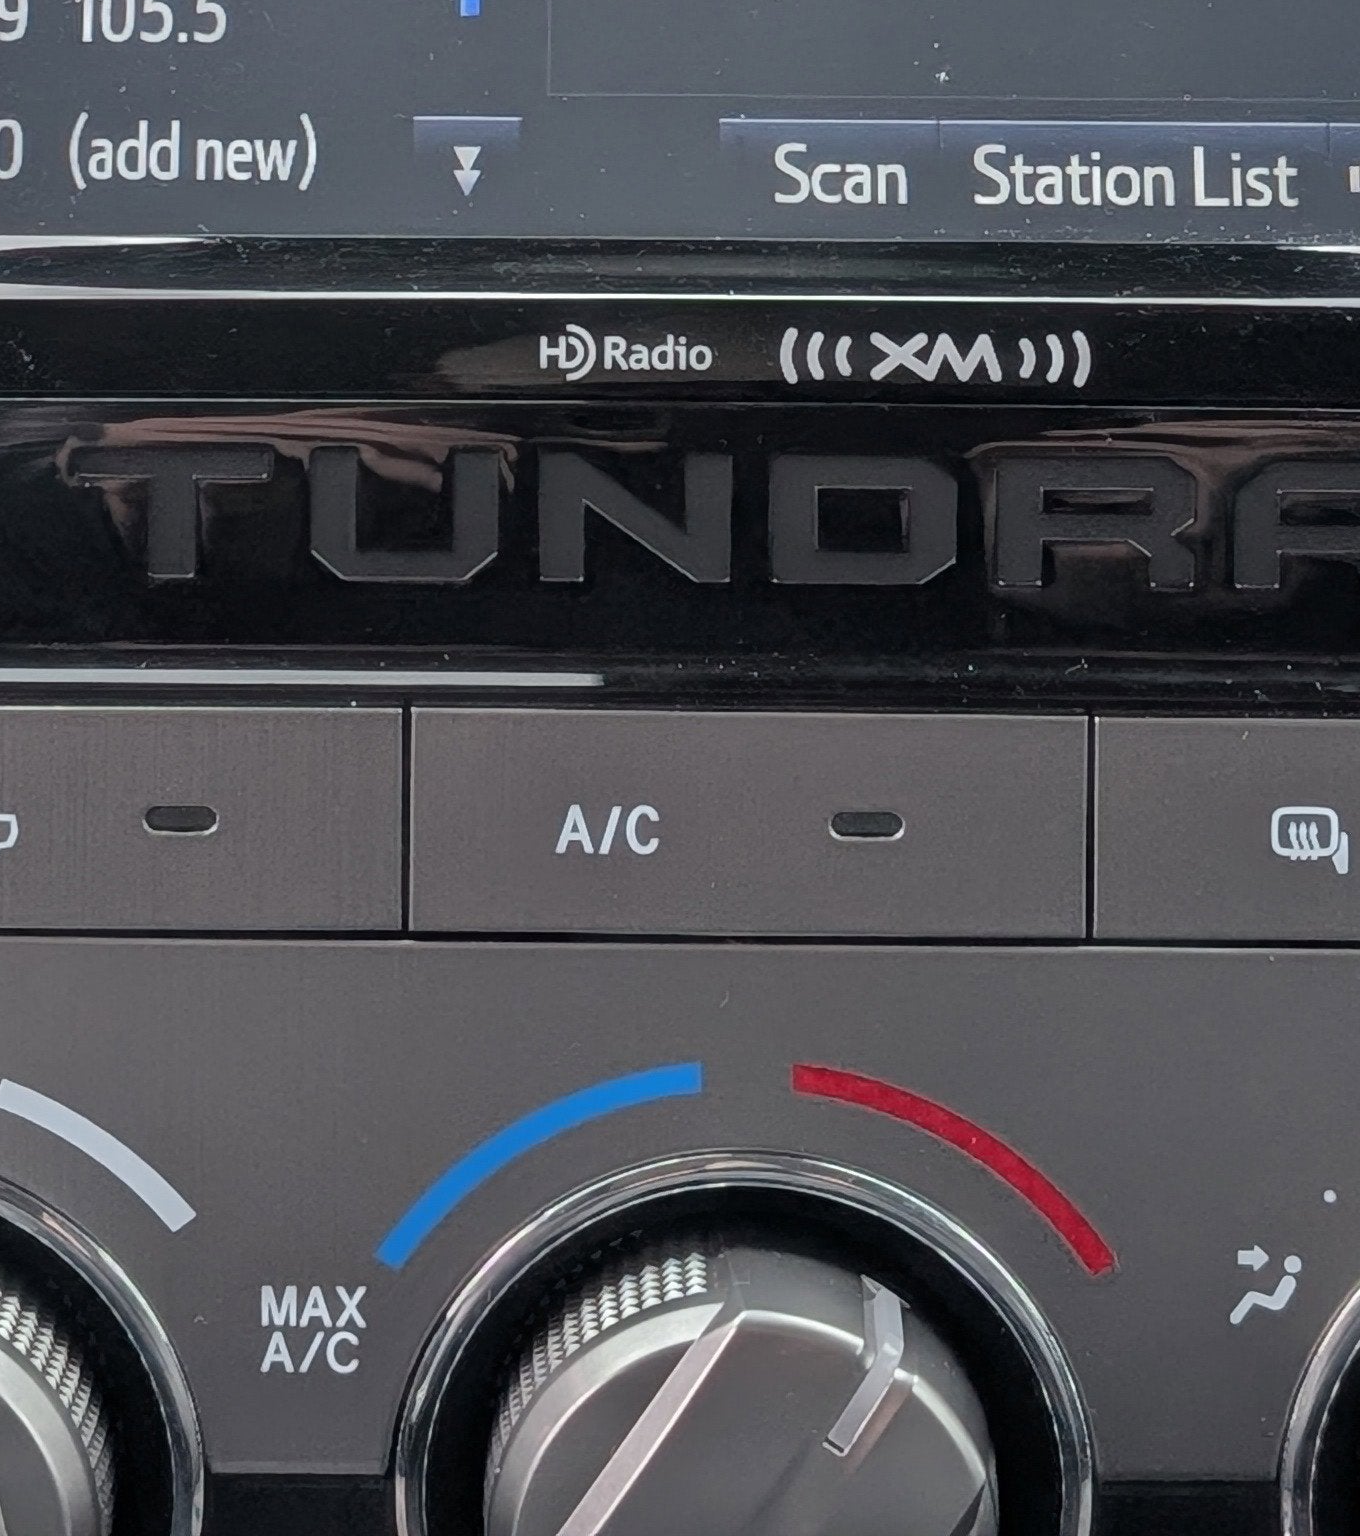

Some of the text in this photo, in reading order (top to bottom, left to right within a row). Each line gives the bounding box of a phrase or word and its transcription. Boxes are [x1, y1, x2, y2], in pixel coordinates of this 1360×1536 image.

[68, 110, 181, 191] (add
[195, 112, 318, 192] new)
[773, 142, 909, 205] Scan
[973, 144, 1300, 209] Station List
[604, 336, 714, 373] Radio
[869, 331, 1003, 383] XM
[554, 803, 660, 856] A/C
[259, 1284, 367, 1328] MAX
[259, 1331, 360, 1375] A/C
